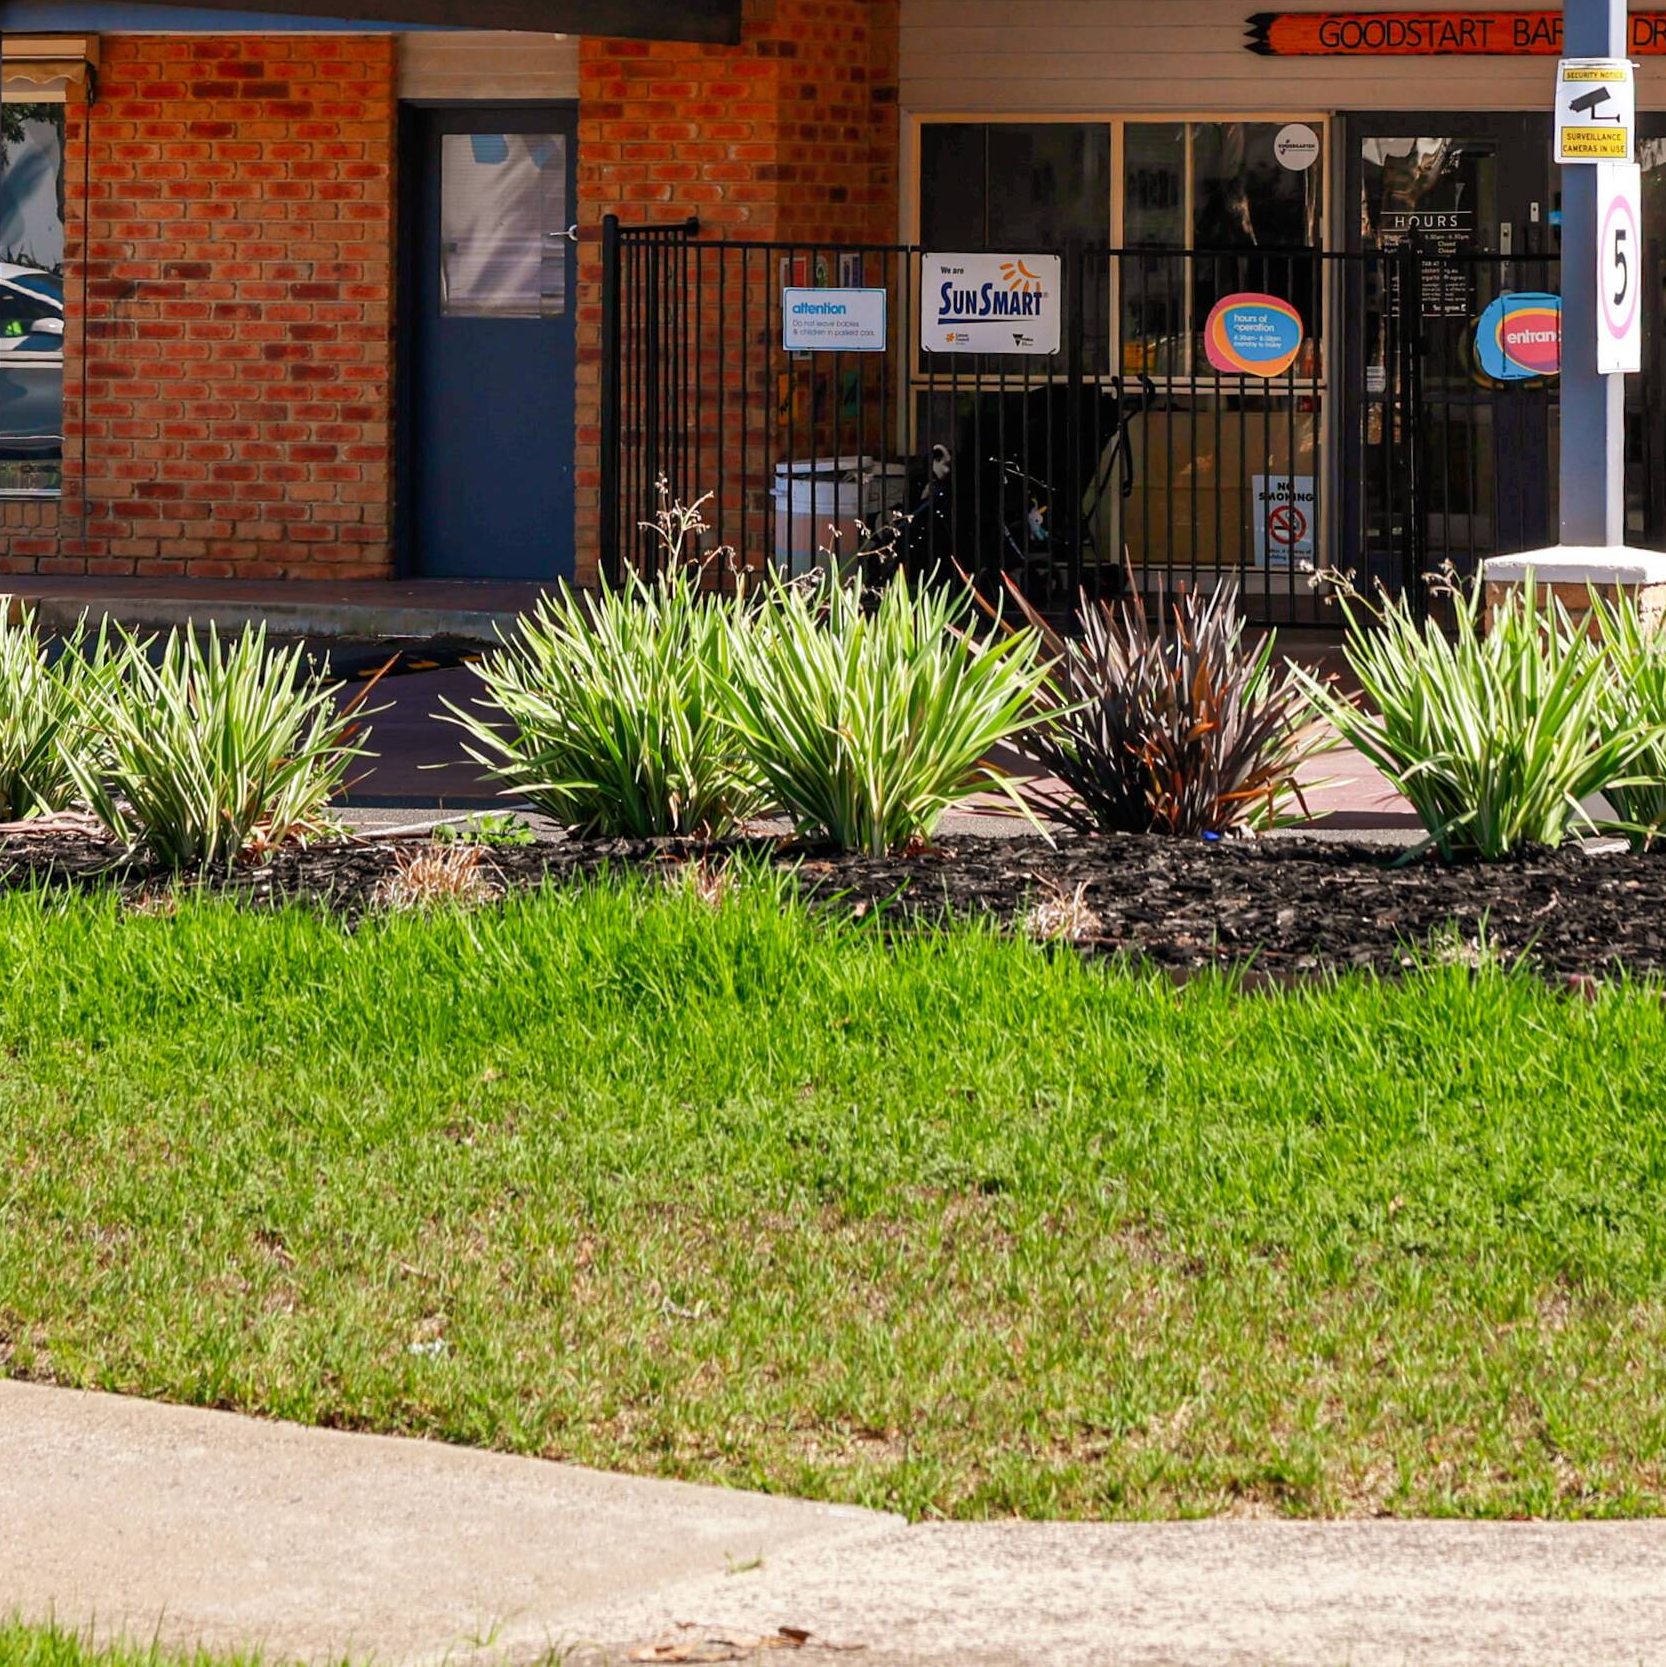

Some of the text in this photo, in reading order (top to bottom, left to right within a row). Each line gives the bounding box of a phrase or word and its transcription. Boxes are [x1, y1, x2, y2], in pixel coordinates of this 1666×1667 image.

[1319, 19, 1495, 48] GOODSTART
[1566, 133, 1621, 141] SURVEILLANCE
[1563, 145, 1625, 153] CAMERAS IN USE
[1395, 215, 1458, 228] HOURS
[940, 266, 951, 274] We
[1613, 229, 1628, 306] 5
[792, 302, 846, 314] attention
[1234, 314, 1268, 322] hours of
[1234, 324, 1275, 333] operation
[1506, 329, 1561, 344] entran
[1258, 493, 1314, 502] SMOKING
